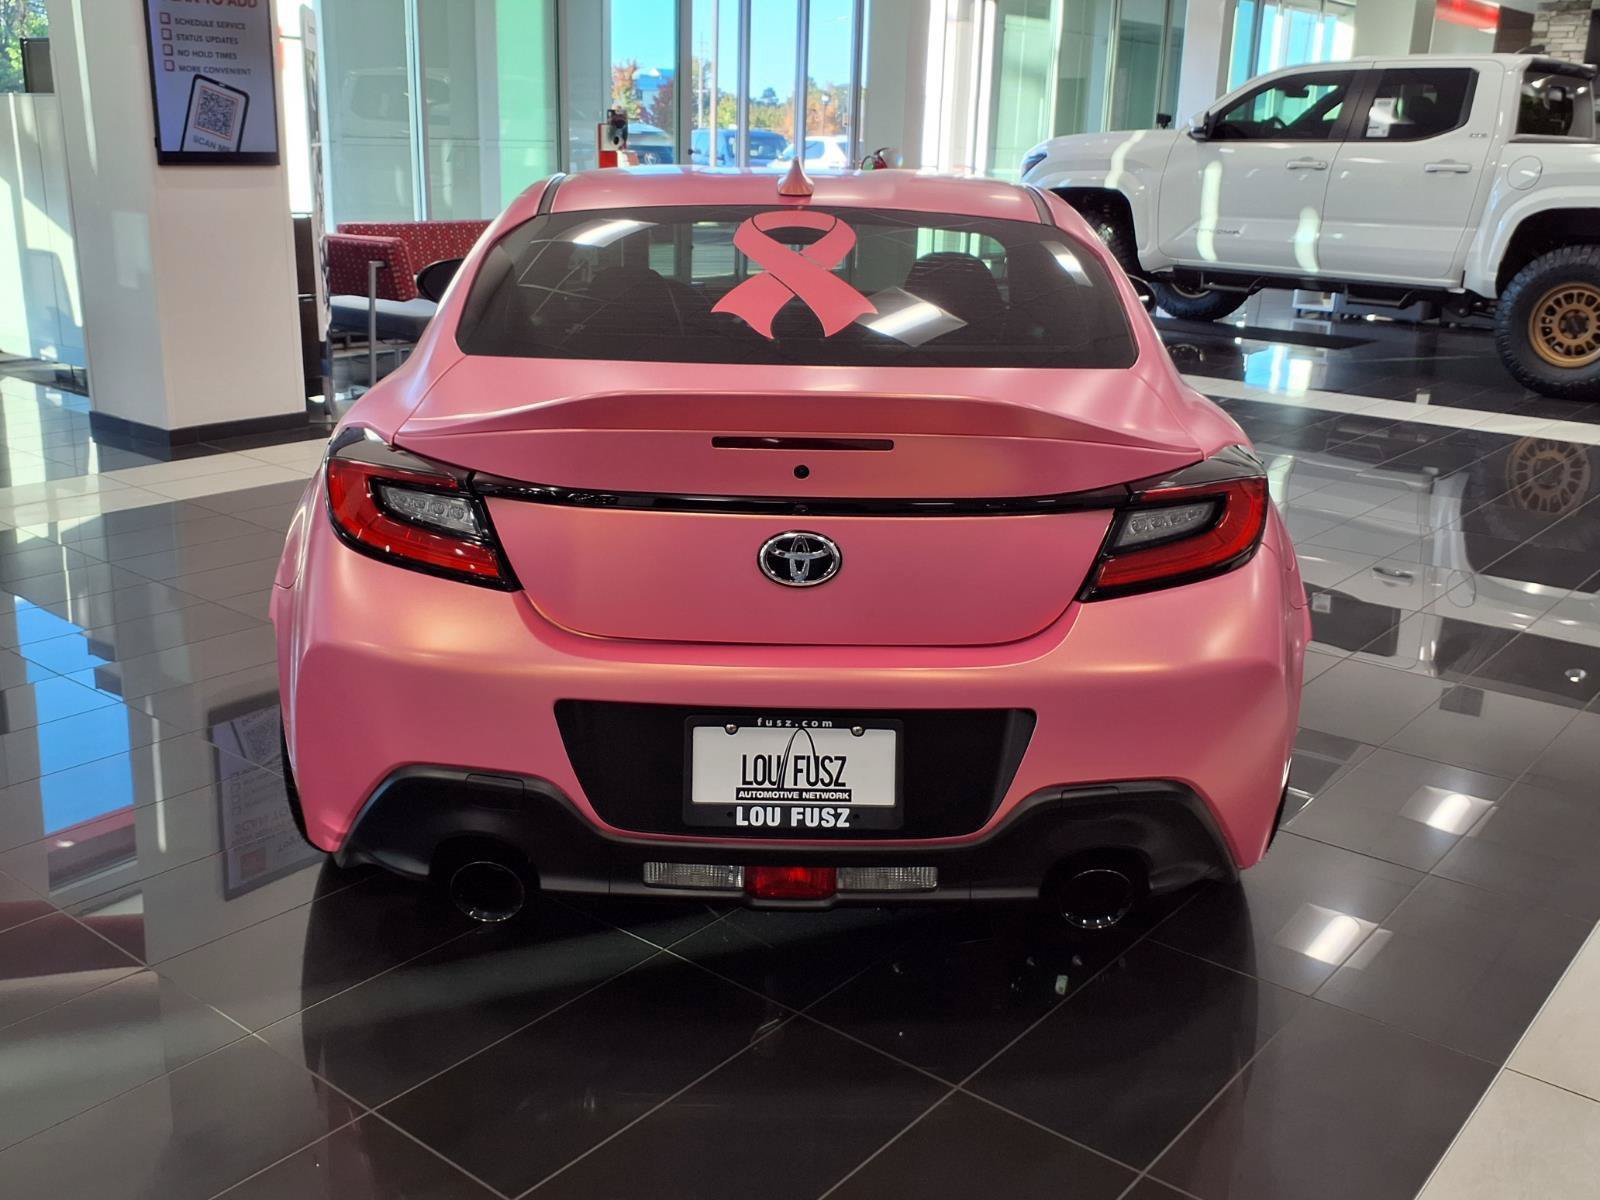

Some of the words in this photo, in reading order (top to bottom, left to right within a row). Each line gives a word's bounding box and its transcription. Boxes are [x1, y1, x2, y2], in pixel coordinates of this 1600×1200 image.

[175, 18, 214, 28] SCHEDULE
[216, 21, 246, 30] SERVICE
[176, 33, 203, 42] STATUS
[206, 36, 239, 45] UPDATES
[177, 49, 190, 57] NO
[192, 50, 213, 58] HOLD
[215, 51, 237, 60] TIMES
[179, 65, 202, 73] MORE
[203, 66, 252, 76] CONVENIENT
[193, 135, 216, 150] SCAN
[757, 717, 833, 728] fusz.com
[742, 754, 782, 786] LOU
[793, 755, 847, 787] FUSZ
[738, 790, 800, 799] AUTOMOTIVE
[802, 791, 850, 800] NETWORK
[736, 806, 781, 826] LOU
[790, 807, 850, 828] FUSZ
